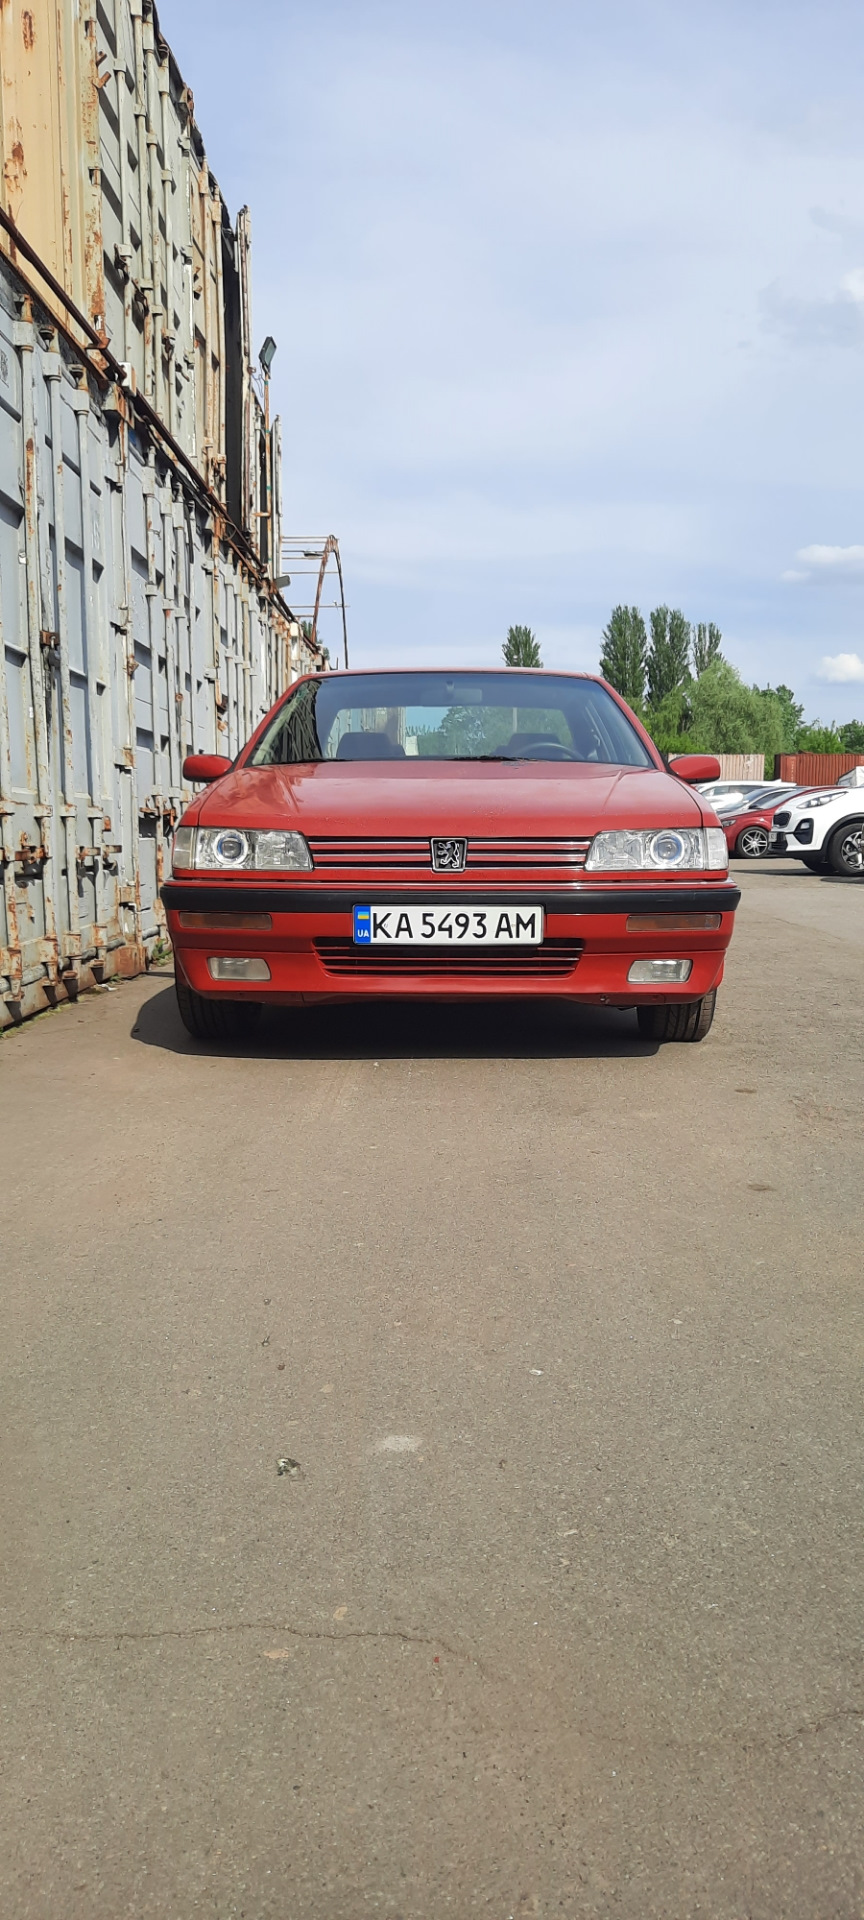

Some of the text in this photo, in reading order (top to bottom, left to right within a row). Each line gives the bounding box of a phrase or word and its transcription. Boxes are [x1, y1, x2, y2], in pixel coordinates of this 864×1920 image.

[357, 929, 370, 937] UA
[372, 913, 535, 938] KA 5493 AM
